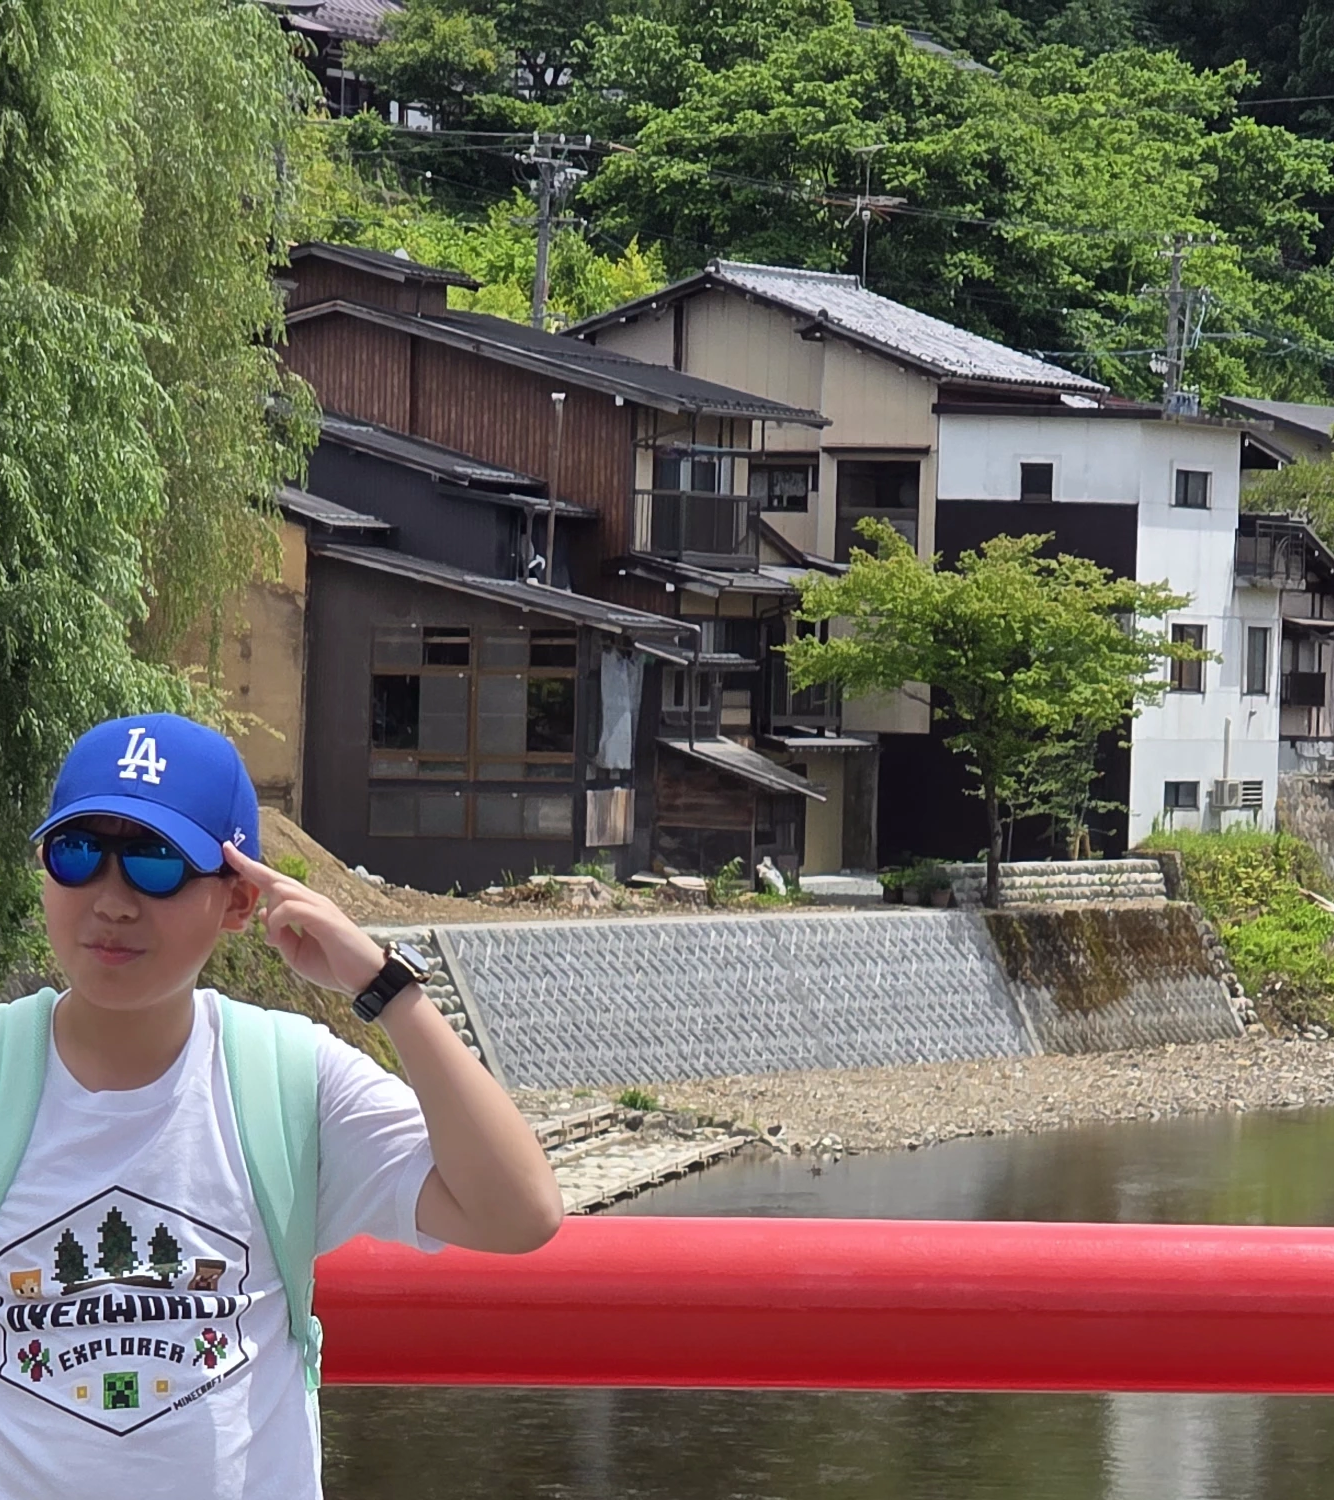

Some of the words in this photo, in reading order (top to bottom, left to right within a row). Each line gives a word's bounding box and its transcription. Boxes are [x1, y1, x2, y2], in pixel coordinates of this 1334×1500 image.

[117, 727, 167, 785] LA
[6, 1294, 237, 1333] OVERWORLD
[58, 1337, 186, 1372] EXPLORER
[172, 1374, 222, 1411] MINECRAFT
